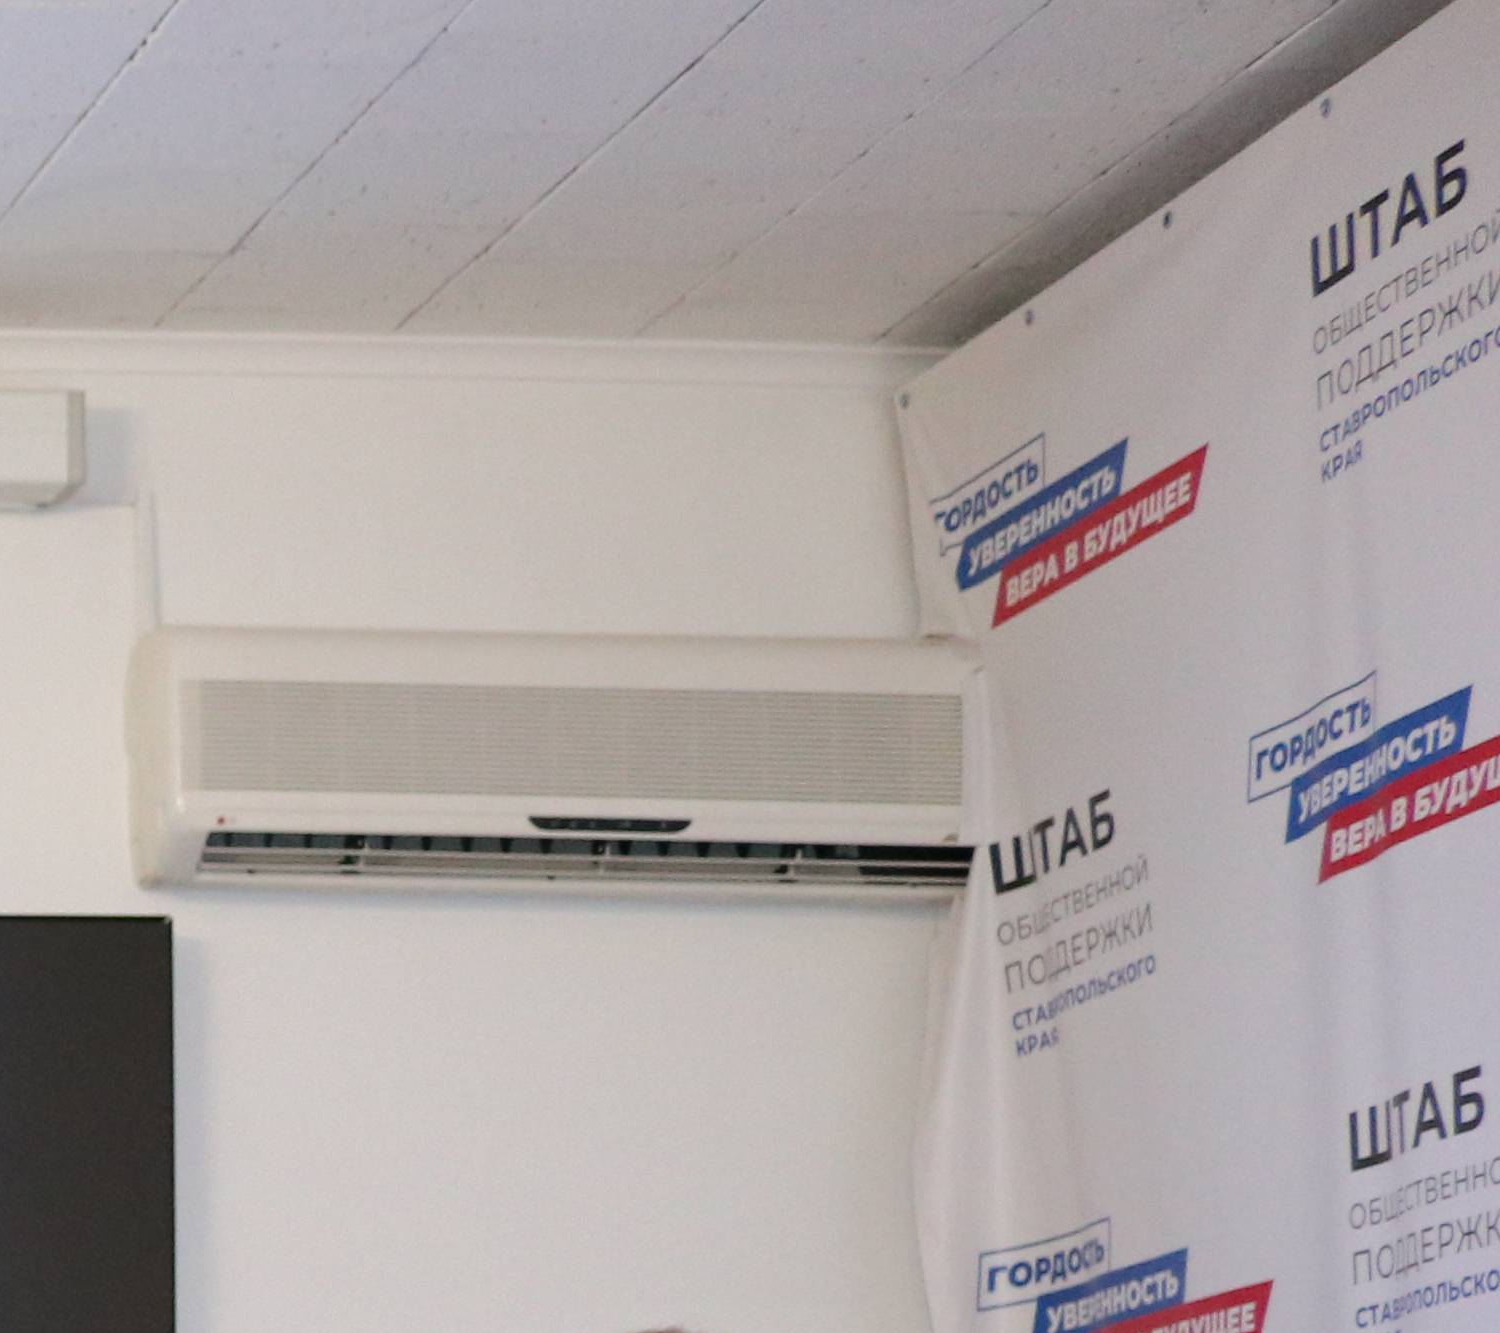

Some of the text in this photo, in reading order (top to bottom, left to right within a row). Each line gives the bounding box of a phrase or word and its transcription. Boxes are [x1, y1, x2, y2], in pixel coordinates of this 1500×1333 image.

[1310, 138, 1468, 298] ШТАБ
[1320, 440, 1364, 484] КРАЯ
[967, 464, 1117, 578] УВЕРЕННОСТЬ
[1004, 471, 1194, 607] ВЕРА В БУДУЩЕЕ
[1255, 696, 1372, 781] ГОРДОСТЬ
[1299, 714, 1458, 824] УВЕРЕННОСТЬ
[989, 789, 1116, 896] ШТАБ
[1329, 808, 1388, 864] ВЕРА
[1389, 795, 1408, 833] В
[1349, 1064, 1485, 1172] ШТАБ
[1349, 1156, 1500, 1230] ОБЩЕСТВЕННО
[1352, 1210, 1500, 1285] ПОДДЕРЖК
[1355, 1268, 1500, 1330] СТАВРОПОЛЬСКО
